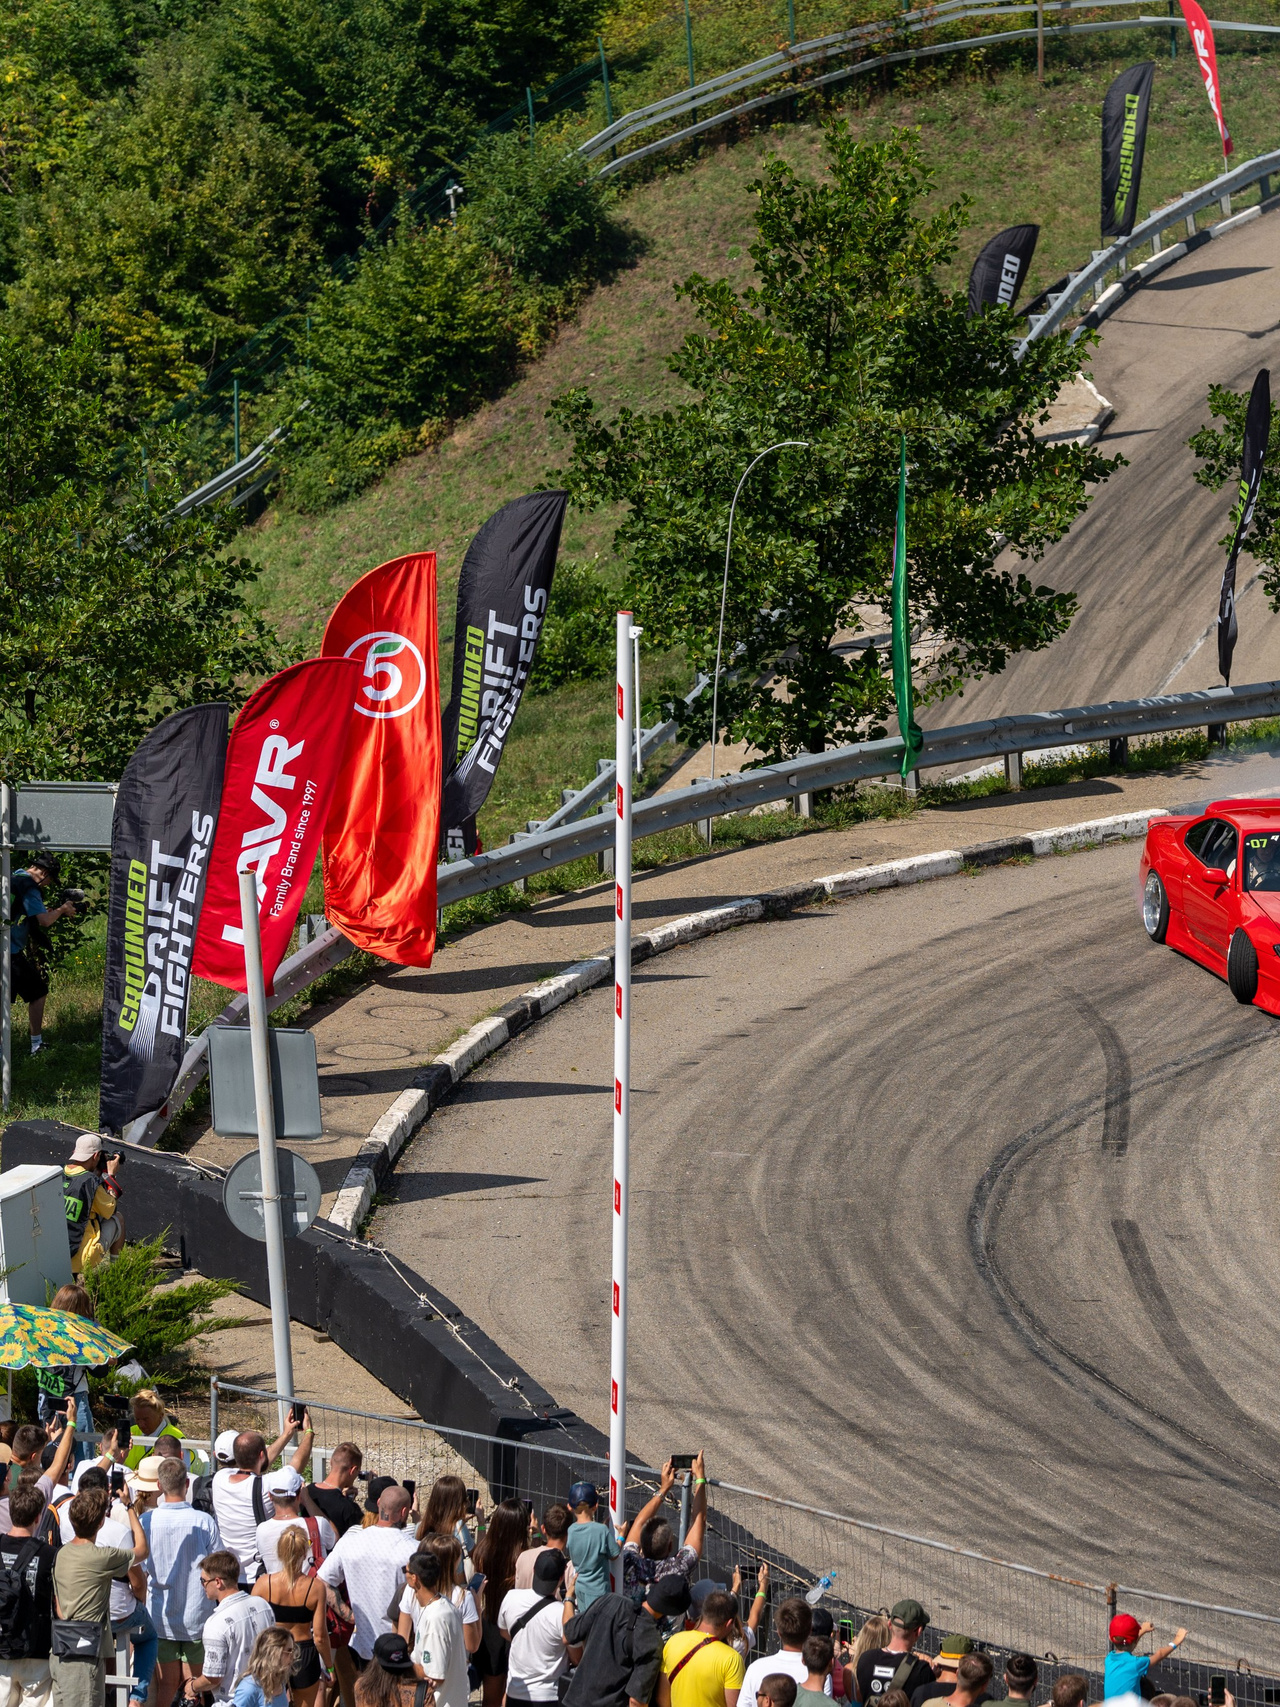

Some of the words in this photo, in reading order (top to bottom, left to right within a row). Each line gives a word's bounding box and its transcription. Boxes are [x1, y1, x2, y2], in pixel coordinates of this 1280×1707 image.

[476, 585, 547, 774] FIGHTERS
[294, 810, 311, 840] since
[302, 780, 318, 806] 1997
[269, 879, 292, 917] Family
[280, 841, 302, 877] Brand
[118, 858, 148, 1032] GROUNDED
[141, 839, 185, 1018] DRIFT
[160, 810, 214, 1039] FIGHTERS
